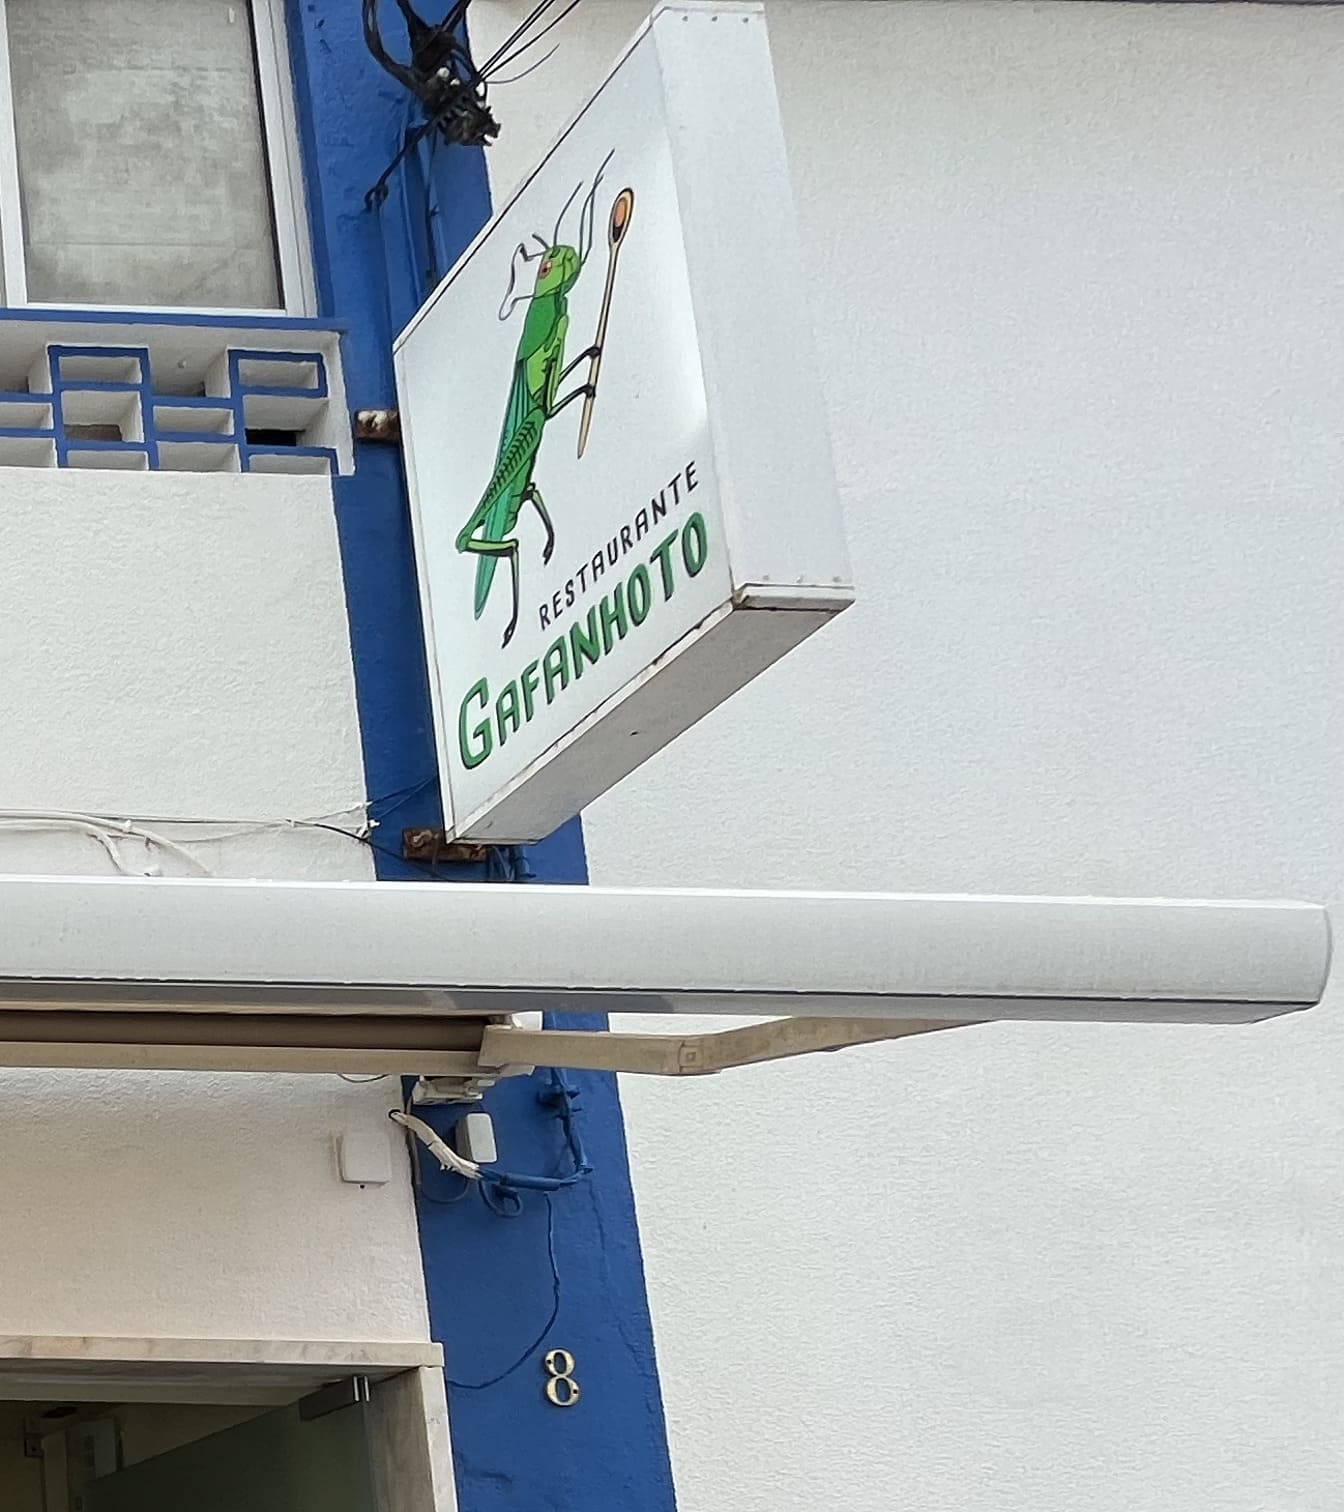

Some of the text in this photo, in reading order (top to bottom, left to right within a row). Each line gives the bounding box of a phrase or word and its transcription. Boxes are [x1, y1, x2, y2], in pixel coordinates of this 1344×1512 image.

[540, 460, 699, 630] RESTAURANTE
[457, 511, 709, 769] GAFANHOTO
[544, 1348, 580, 1407] 8
